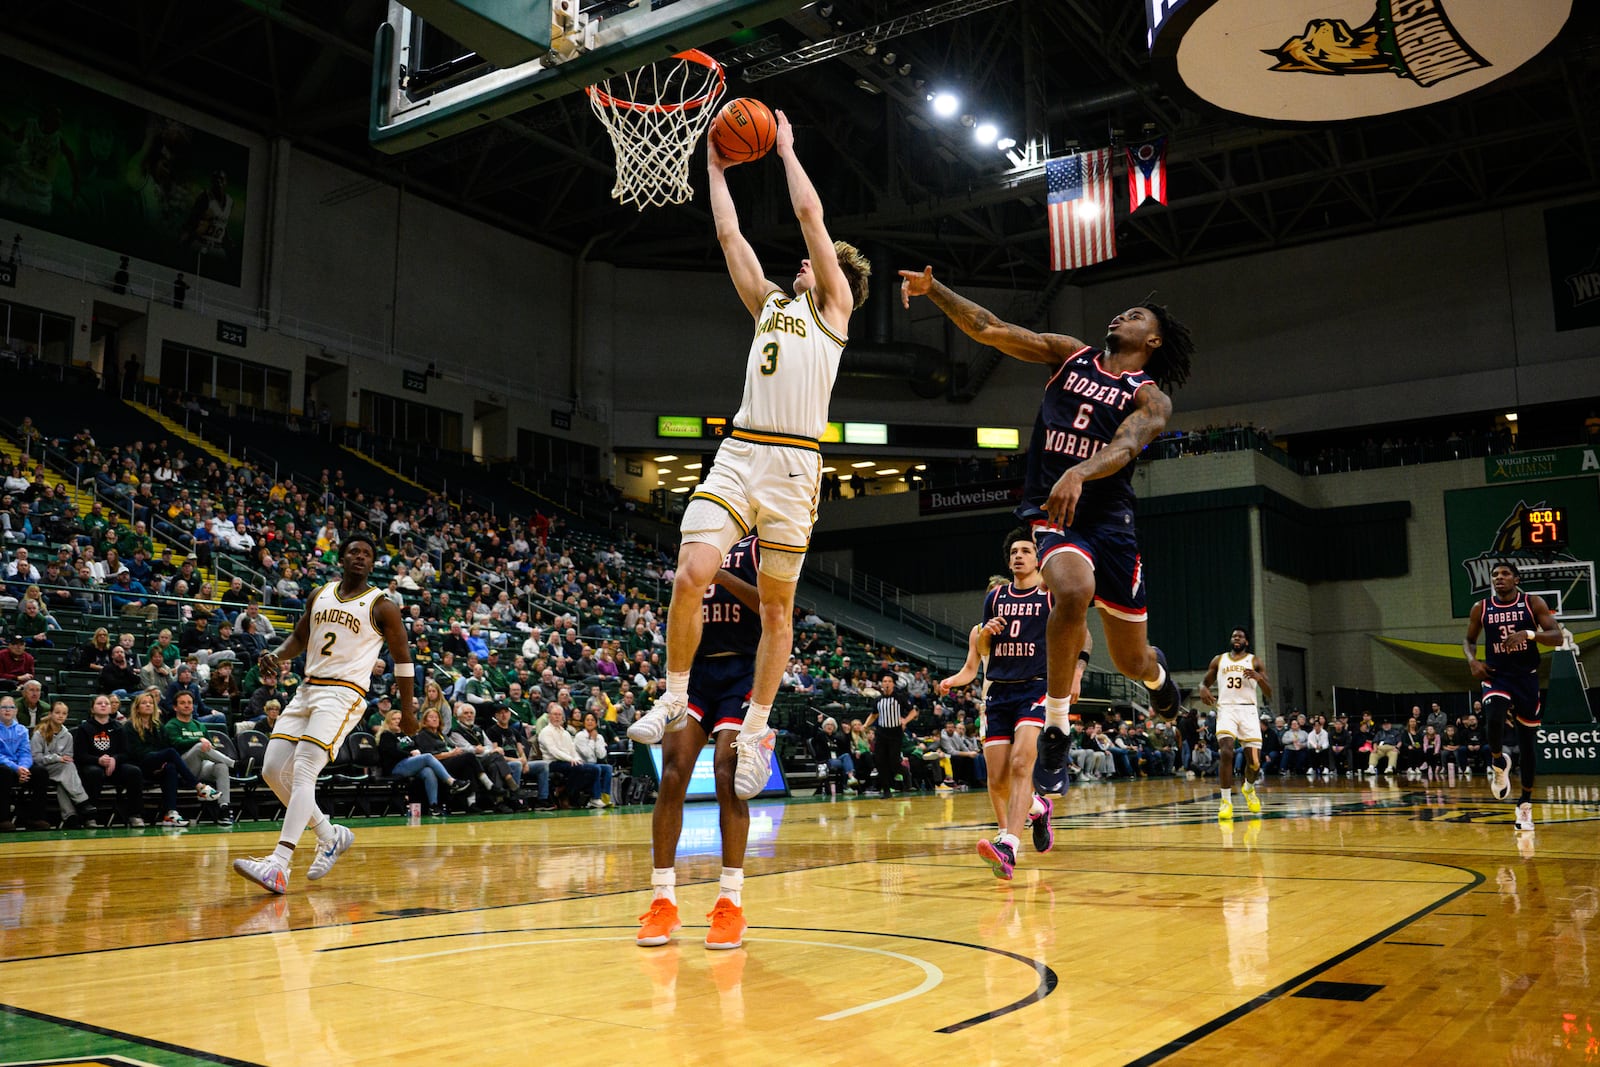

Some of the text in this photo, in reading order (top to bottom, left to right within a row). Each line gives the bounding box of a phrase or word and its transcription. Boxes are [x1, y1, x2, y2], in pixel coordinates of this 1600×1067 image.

[1394, 13, 1481, 85] WRIGHT
[221, 331, 243, 344] 221
[760, 342, 780, 376] 3
[1063, 371, 1133, 411] ROBERT
[1072, 403, 1094, 430] 6
[1044, 429, 1109, 459] MORRI
[1496, 454, 1557, 466] WRIGHT STATE
[930, 488, 1011, 508] Budweiser
[1529, 510, 1560, 523] 10:01
[1531, 522, 1557, 543] 27
[997, 603, 1042, 617] ROBERT
[1488, 611, 1524, 624] ROBERT
[314, 608, 361, 634] RAIDERS
[1009, 620, 1021, 638] 0
[320, 631, 337, 657] 2
[994, 642, 1036, 657] MORRIS
[1226, 676, 1242, 689] 33
[1536, 729, 1600, 744] Select
[1543, 747, 1597, 759] SIGNS
